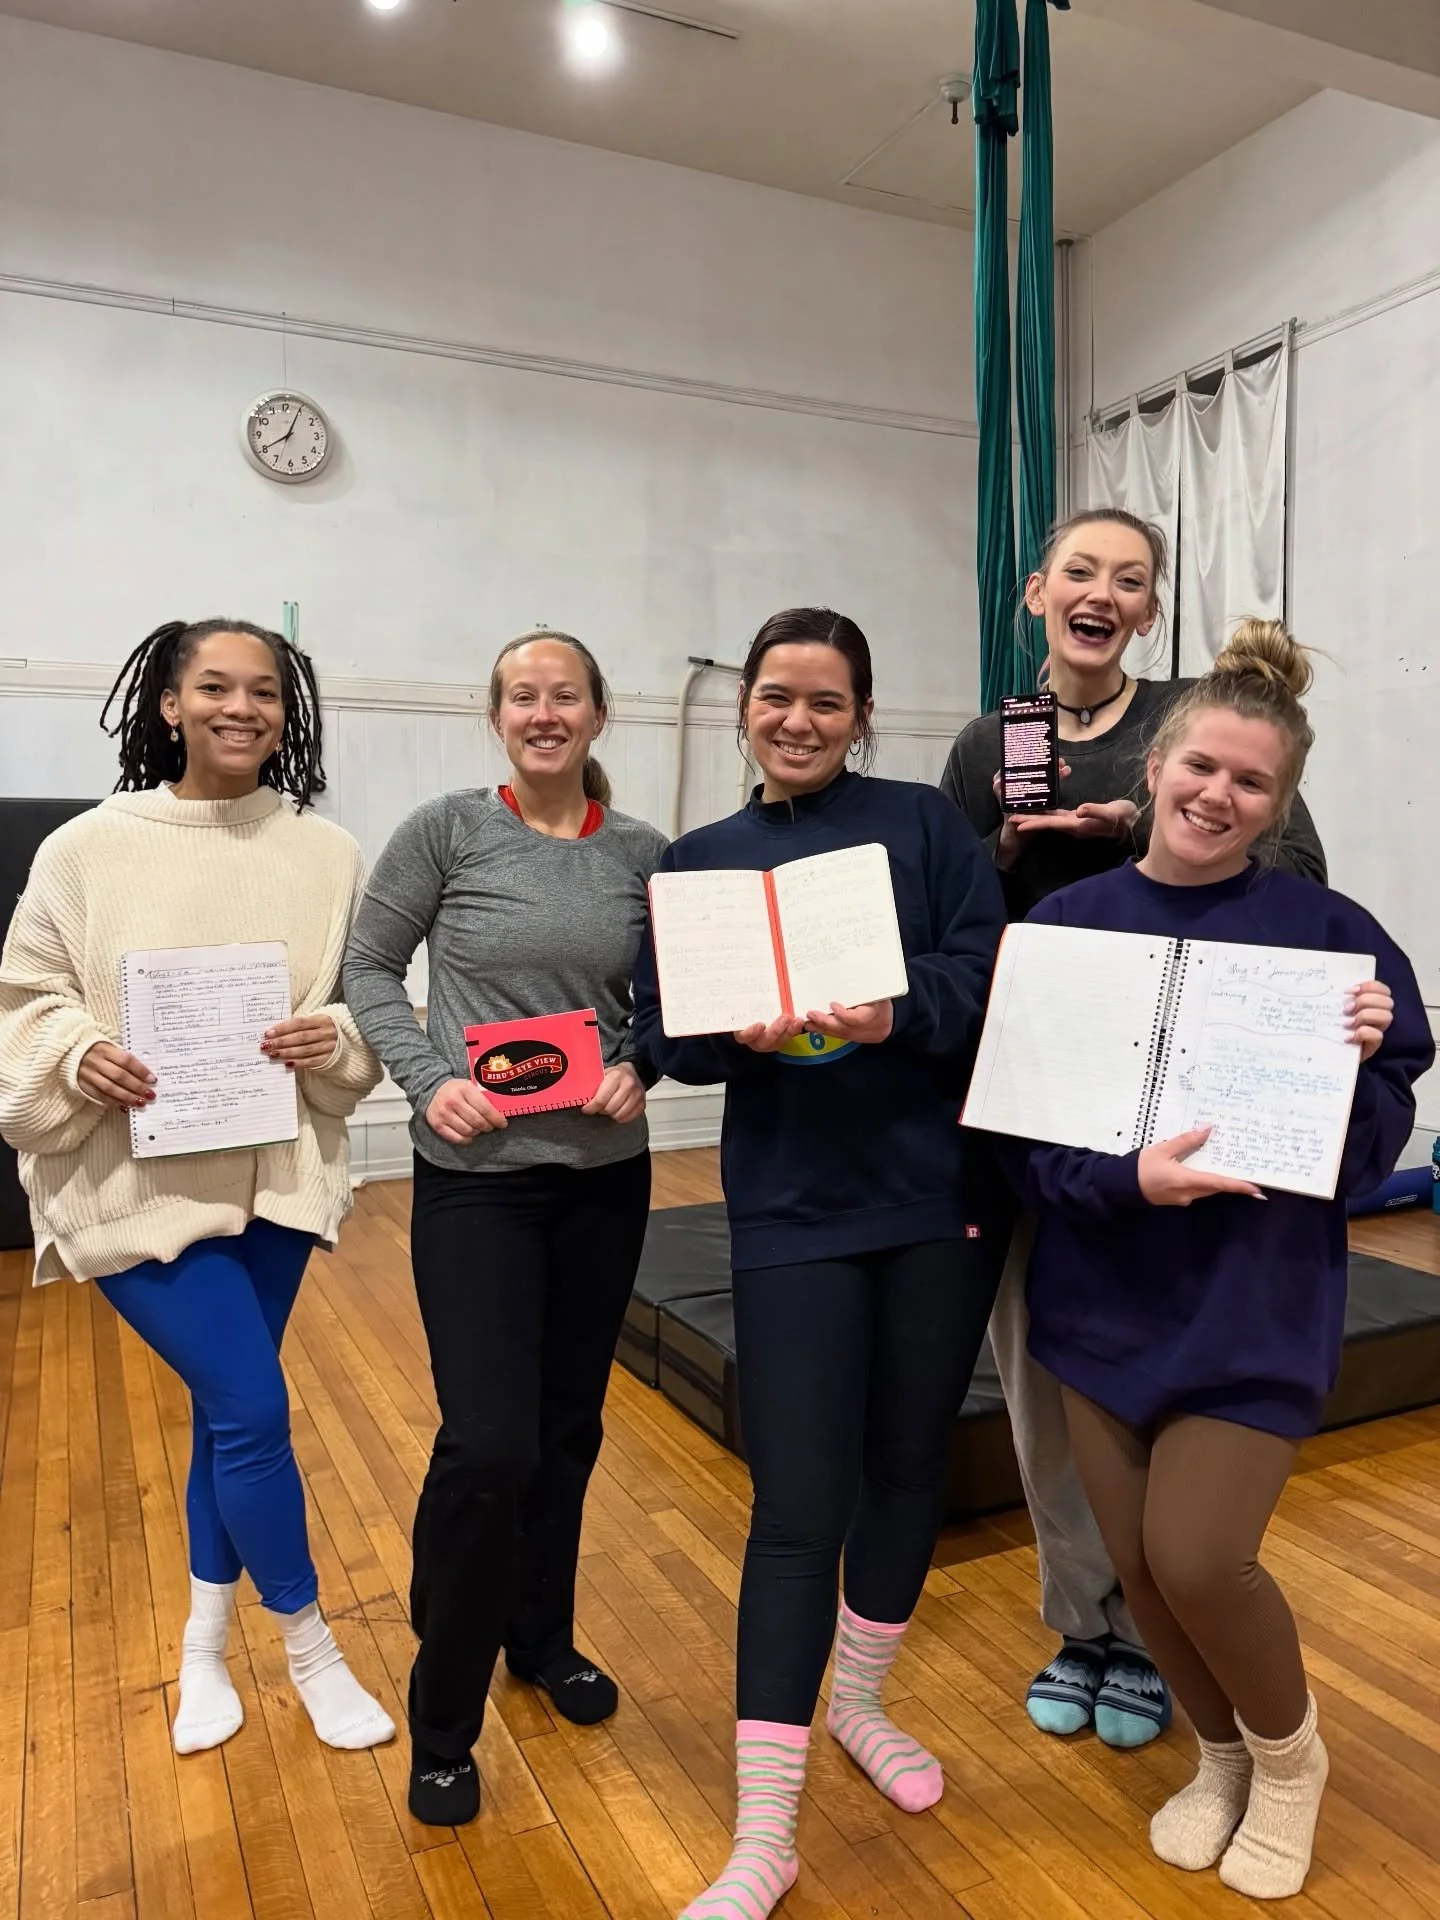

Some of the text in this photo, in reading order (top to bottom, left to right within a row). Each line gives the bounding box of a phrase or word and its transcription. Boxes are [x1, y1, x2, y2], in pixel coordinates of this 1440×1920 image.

[260, 417, 269, 426] 10
[309, 418, 314, 426] 2
[256, 431, 262, 439] 9
[314, 432, 319, 440] 3
[262, 445, 268, 453] 8
[311, 446, 316, 454] 4
[274, 455, 279, 463] 7
[288, 459, 294, 467] 6
[302, 456, 307, 464] 5
[488, 1057, 556, 1079] BIRD'S EYE VIEW
[523, 1069, 548, 1080] CIRCUS
